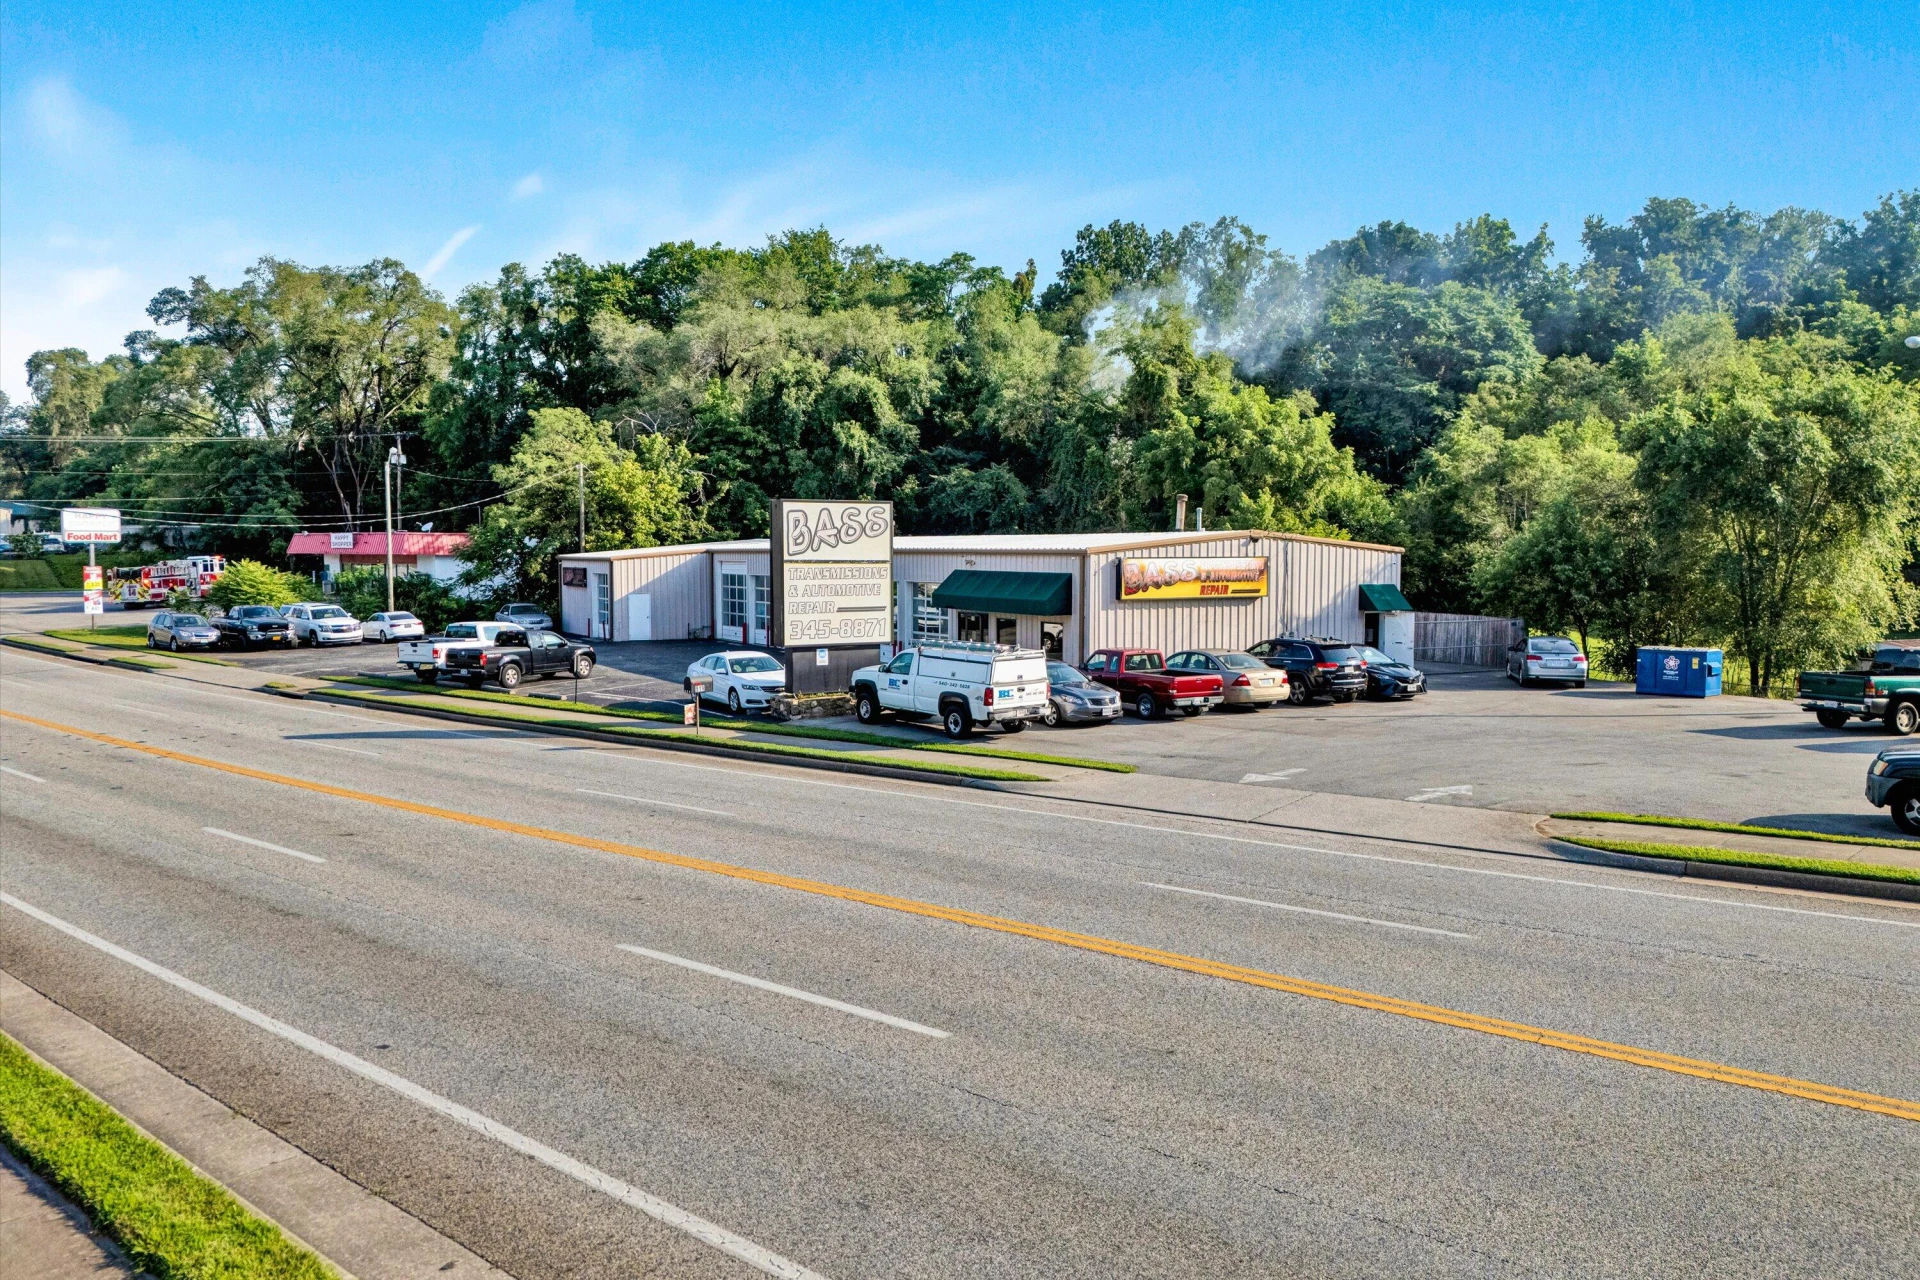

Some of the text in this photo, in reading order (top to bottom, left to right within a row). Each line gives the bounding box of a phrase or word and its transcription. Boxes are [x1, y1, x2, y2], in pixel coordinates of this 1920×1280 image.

[67, 532, 118, 540] Food Mart
[787, 506, 889, 556] BASS
[788, 567, 888, 581] TRANSMISSIONS
[1124, 560, 1199, 596] BASS
[788, 584, 881, 597] & AUTOMOTIVE
[1200, 585, 1229, 595] REPAIR
[788, 601, 835, 614] REPAIR
[789, 618, 886, 640] 345-8871
